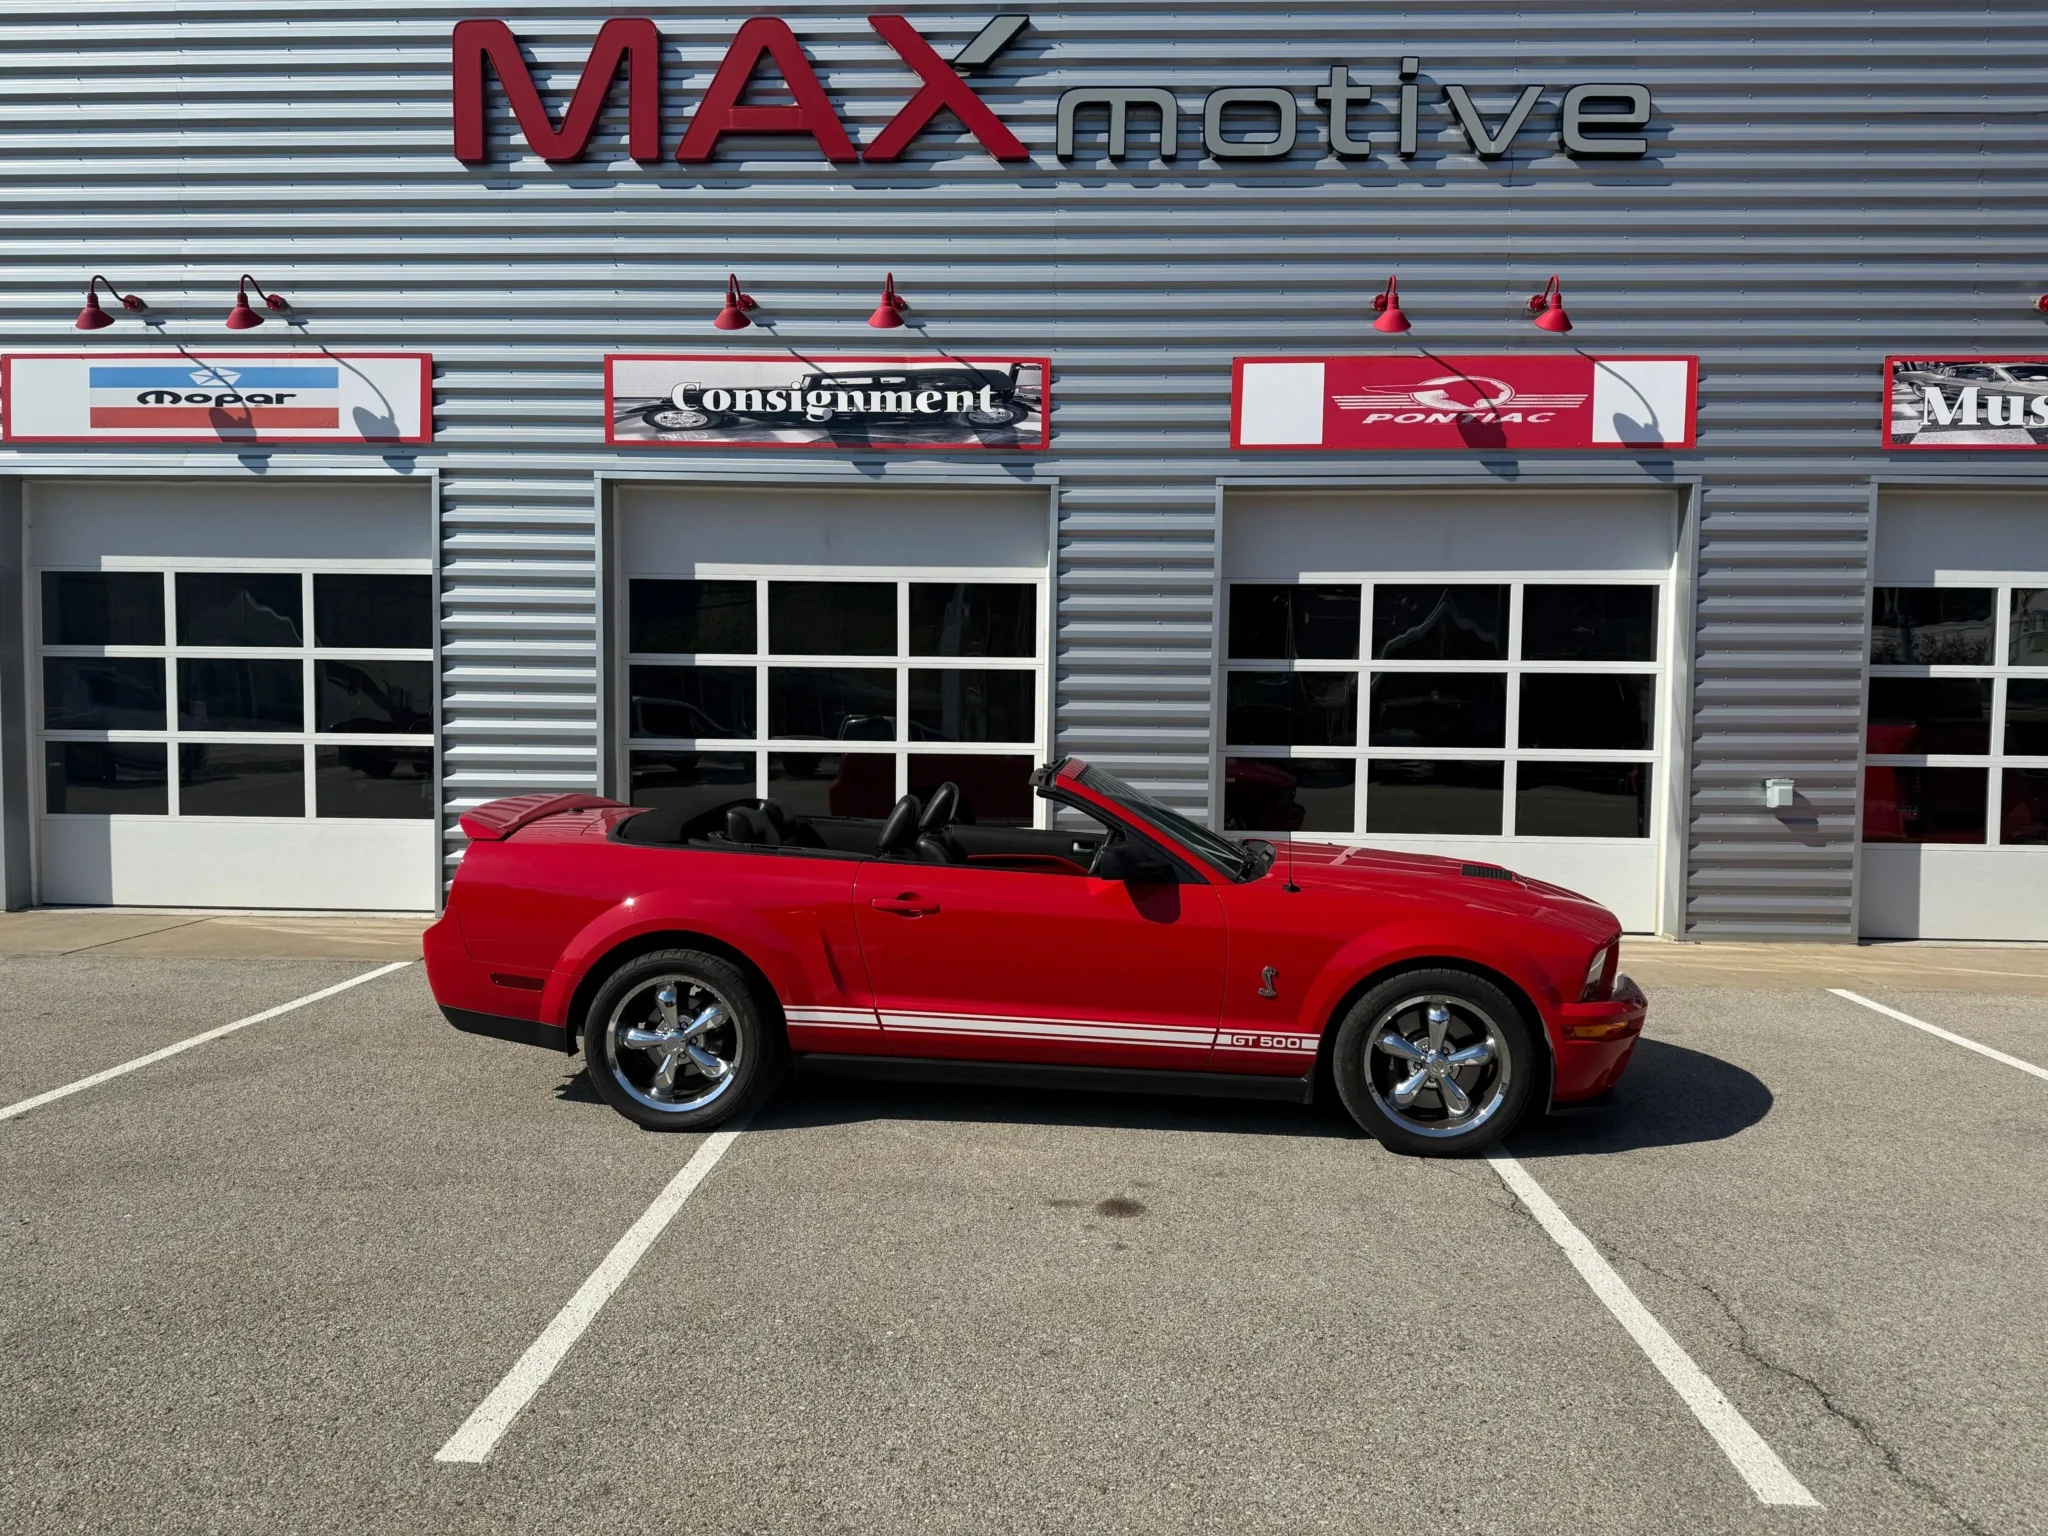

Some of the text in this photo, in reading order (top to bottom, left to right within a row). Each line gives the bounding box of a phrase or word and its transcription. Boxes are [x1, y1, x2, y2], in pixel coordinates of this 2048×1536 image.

[453, 14, 1652, 163] MAX motive
[137, 390, 297, 408] Mopar
[671, 381, 1000, 422] Consignment
[1361, 412, 1557, 424] PONTIAC
[1232, 1034, 1301, 1049] GT 500
